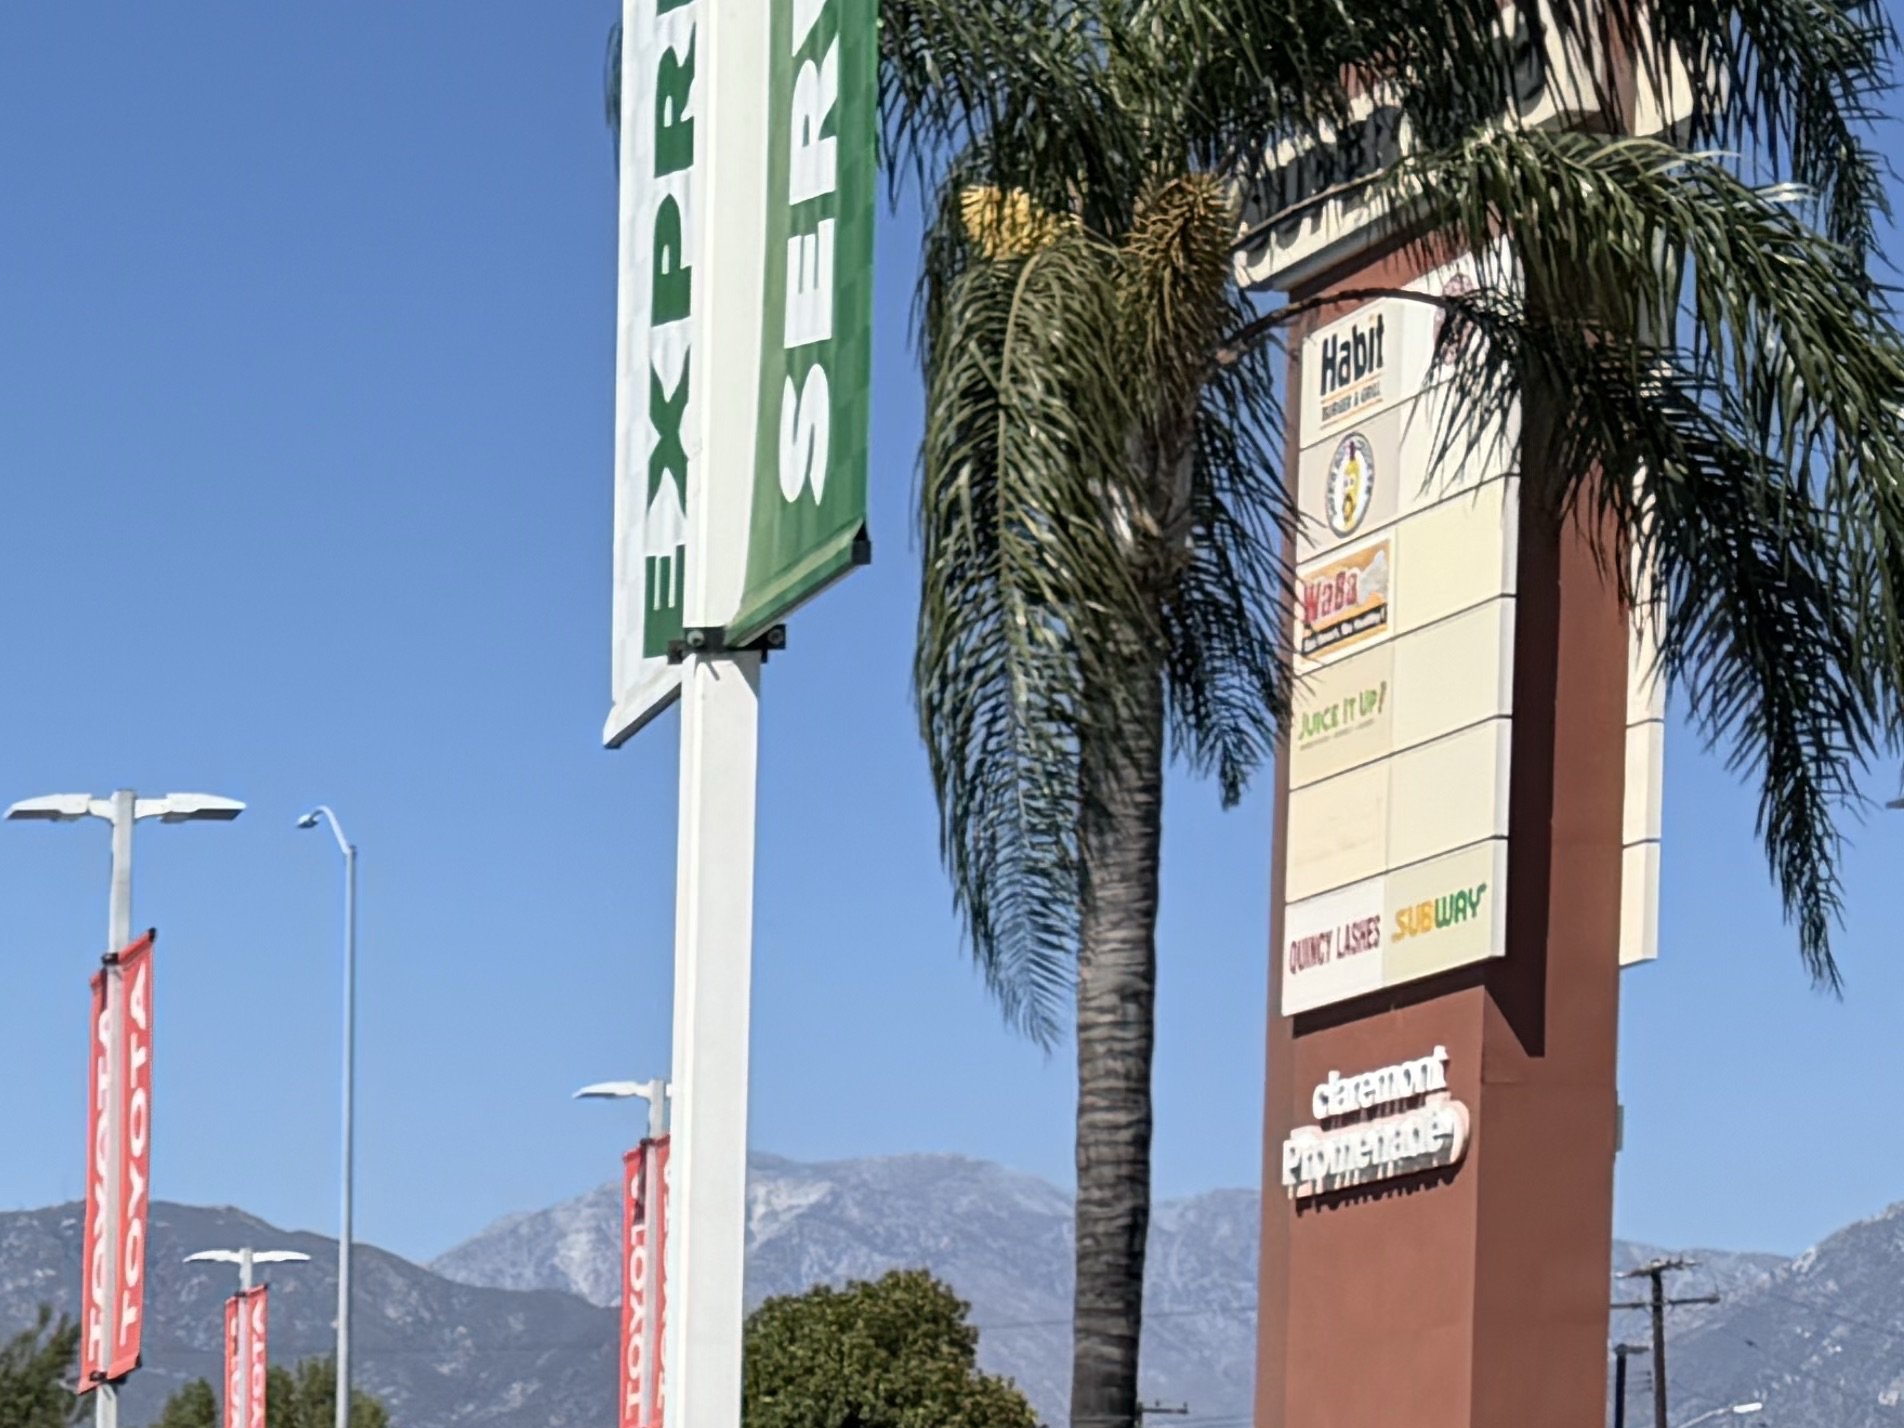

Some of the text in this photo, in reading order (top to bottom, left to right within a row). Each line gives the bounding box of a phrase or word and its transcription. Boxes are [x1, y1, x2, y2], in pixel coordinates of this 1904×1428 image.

[643, 0, 696, 659] EXPR
[1320, 313, 1384, 396] Habit
[1289, 914, 1381, 975] QUINCY LASHES
[1391, 882, 1487, 944] SUBWAY
[118, 962, 147, 1347] TOYOTA
